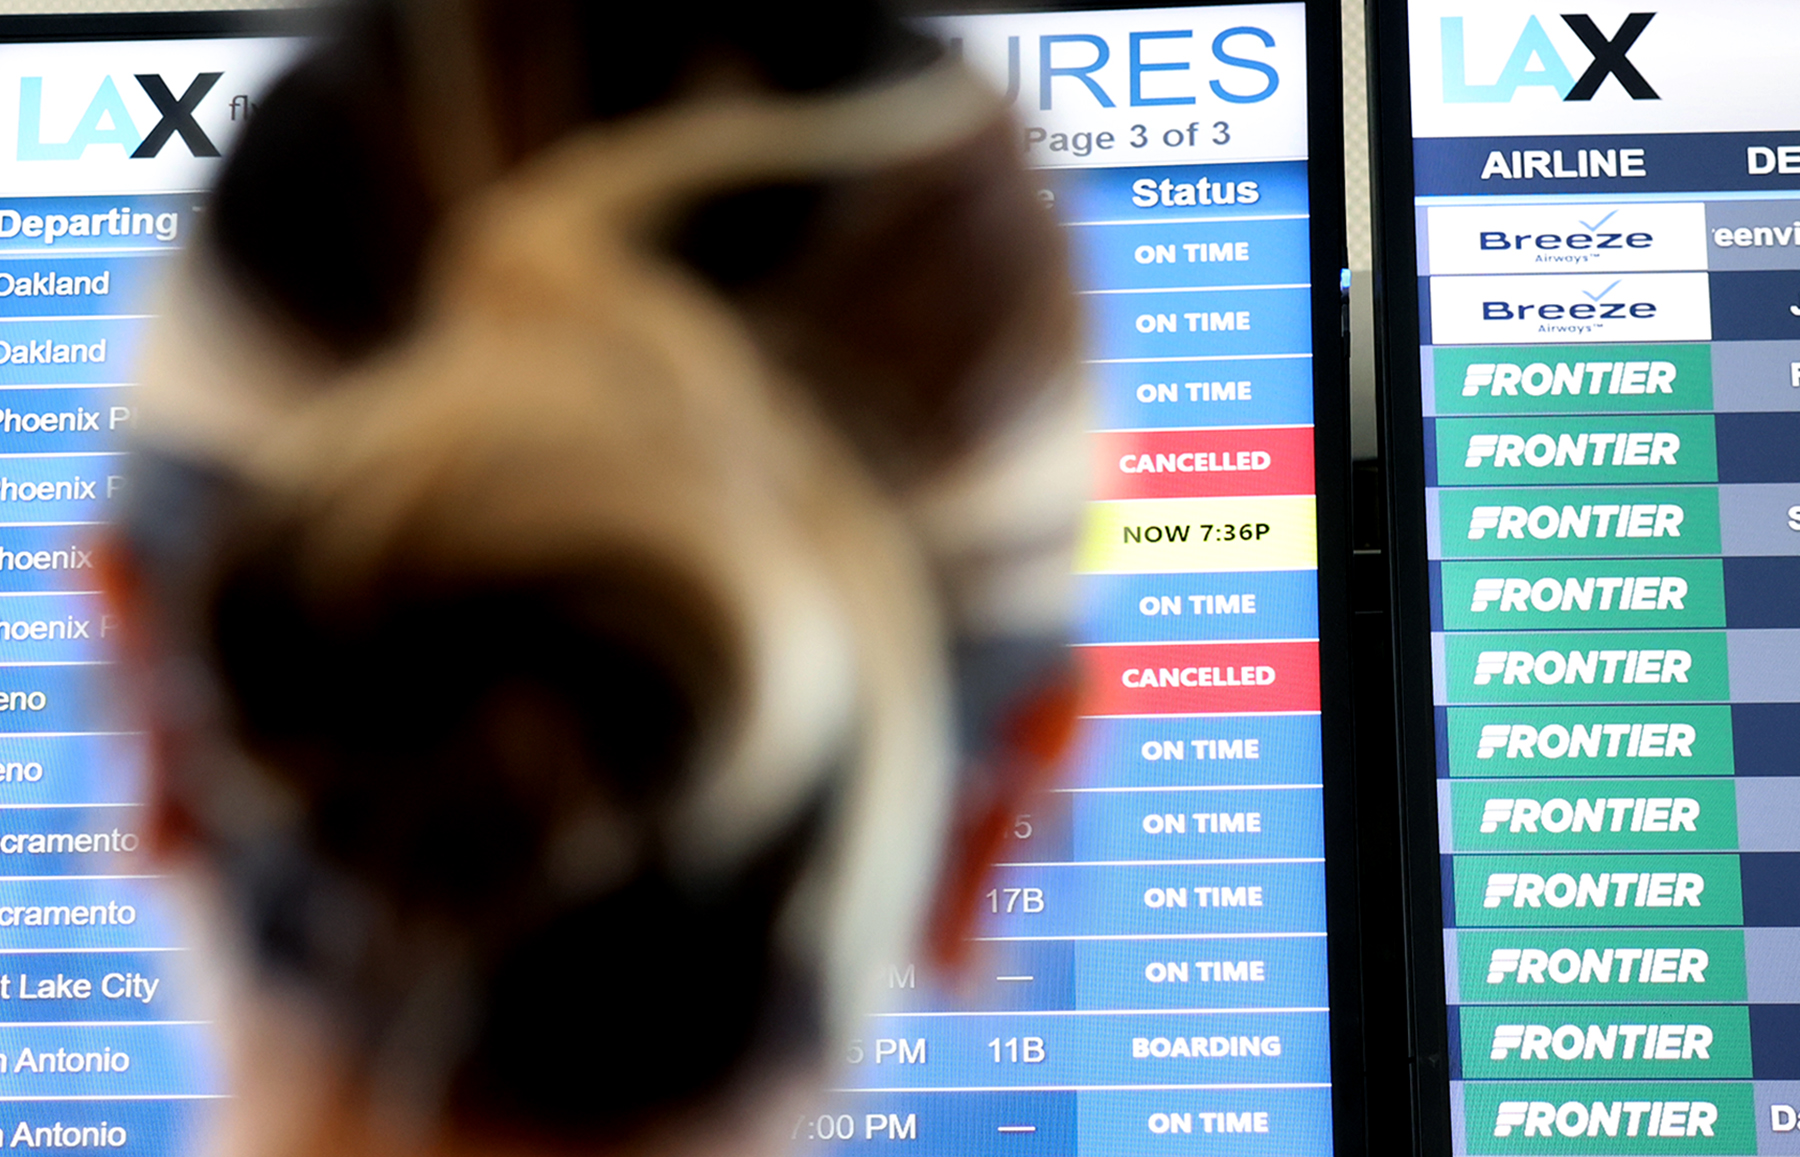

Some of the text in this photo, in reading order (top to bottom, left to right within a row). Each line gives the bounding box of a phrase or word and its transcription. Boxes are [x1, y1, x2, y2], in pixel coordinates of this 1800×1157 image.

[1440, 12, 1661, 103] LAX
[16, 72, 225, 160] LAX
[1023, 121, 1231, 156] Page 3 of 3
[1481, 149, 1646, 179] AIRLINE
[1132, 177, 1259, 208] Status
[1134, 242, 1249, 263] ON TIME
[1480, 232, 1653, 250] Breeze
[1483, 302, 1657, 320] Breeze
[1462, 361, 1677, 396] FRONTIER
[1119, 451, 1270, 474] CANCELLED
[1465, 433, 1680, 467] FRONTIER
[1123, 523, 1270, 543] NOW 7:36P
[1139, 595, 1256, 616] ON TIME
[1471, 576, 1688, 612] FRONTIER
[1122, 666, 1276, 688] CANCELLED
[1477, 723, 1696, 758] FRONTIER
[985, 886, 1262, 913] 17B ON TIME
[1484, 873, 1704, 908] FRONTIER
[1487, 948, 1708, 984] FRONTIER
[19, 974, 91, 999] Lake
[101, 972, 159, 1004] City
[14, 1046, 130, 1073] Antonio
[874, 1039, 926, 1063] PM
[988, 1038, 1045, 1062] 11B
[1132, 1035, 1281, 1058] BOARDING
[11, 1120, 126, 1148] Antonio
[865, 1114, 917, 1139] PM
[1494, 1101, 1718, 1137] FRONTIER
